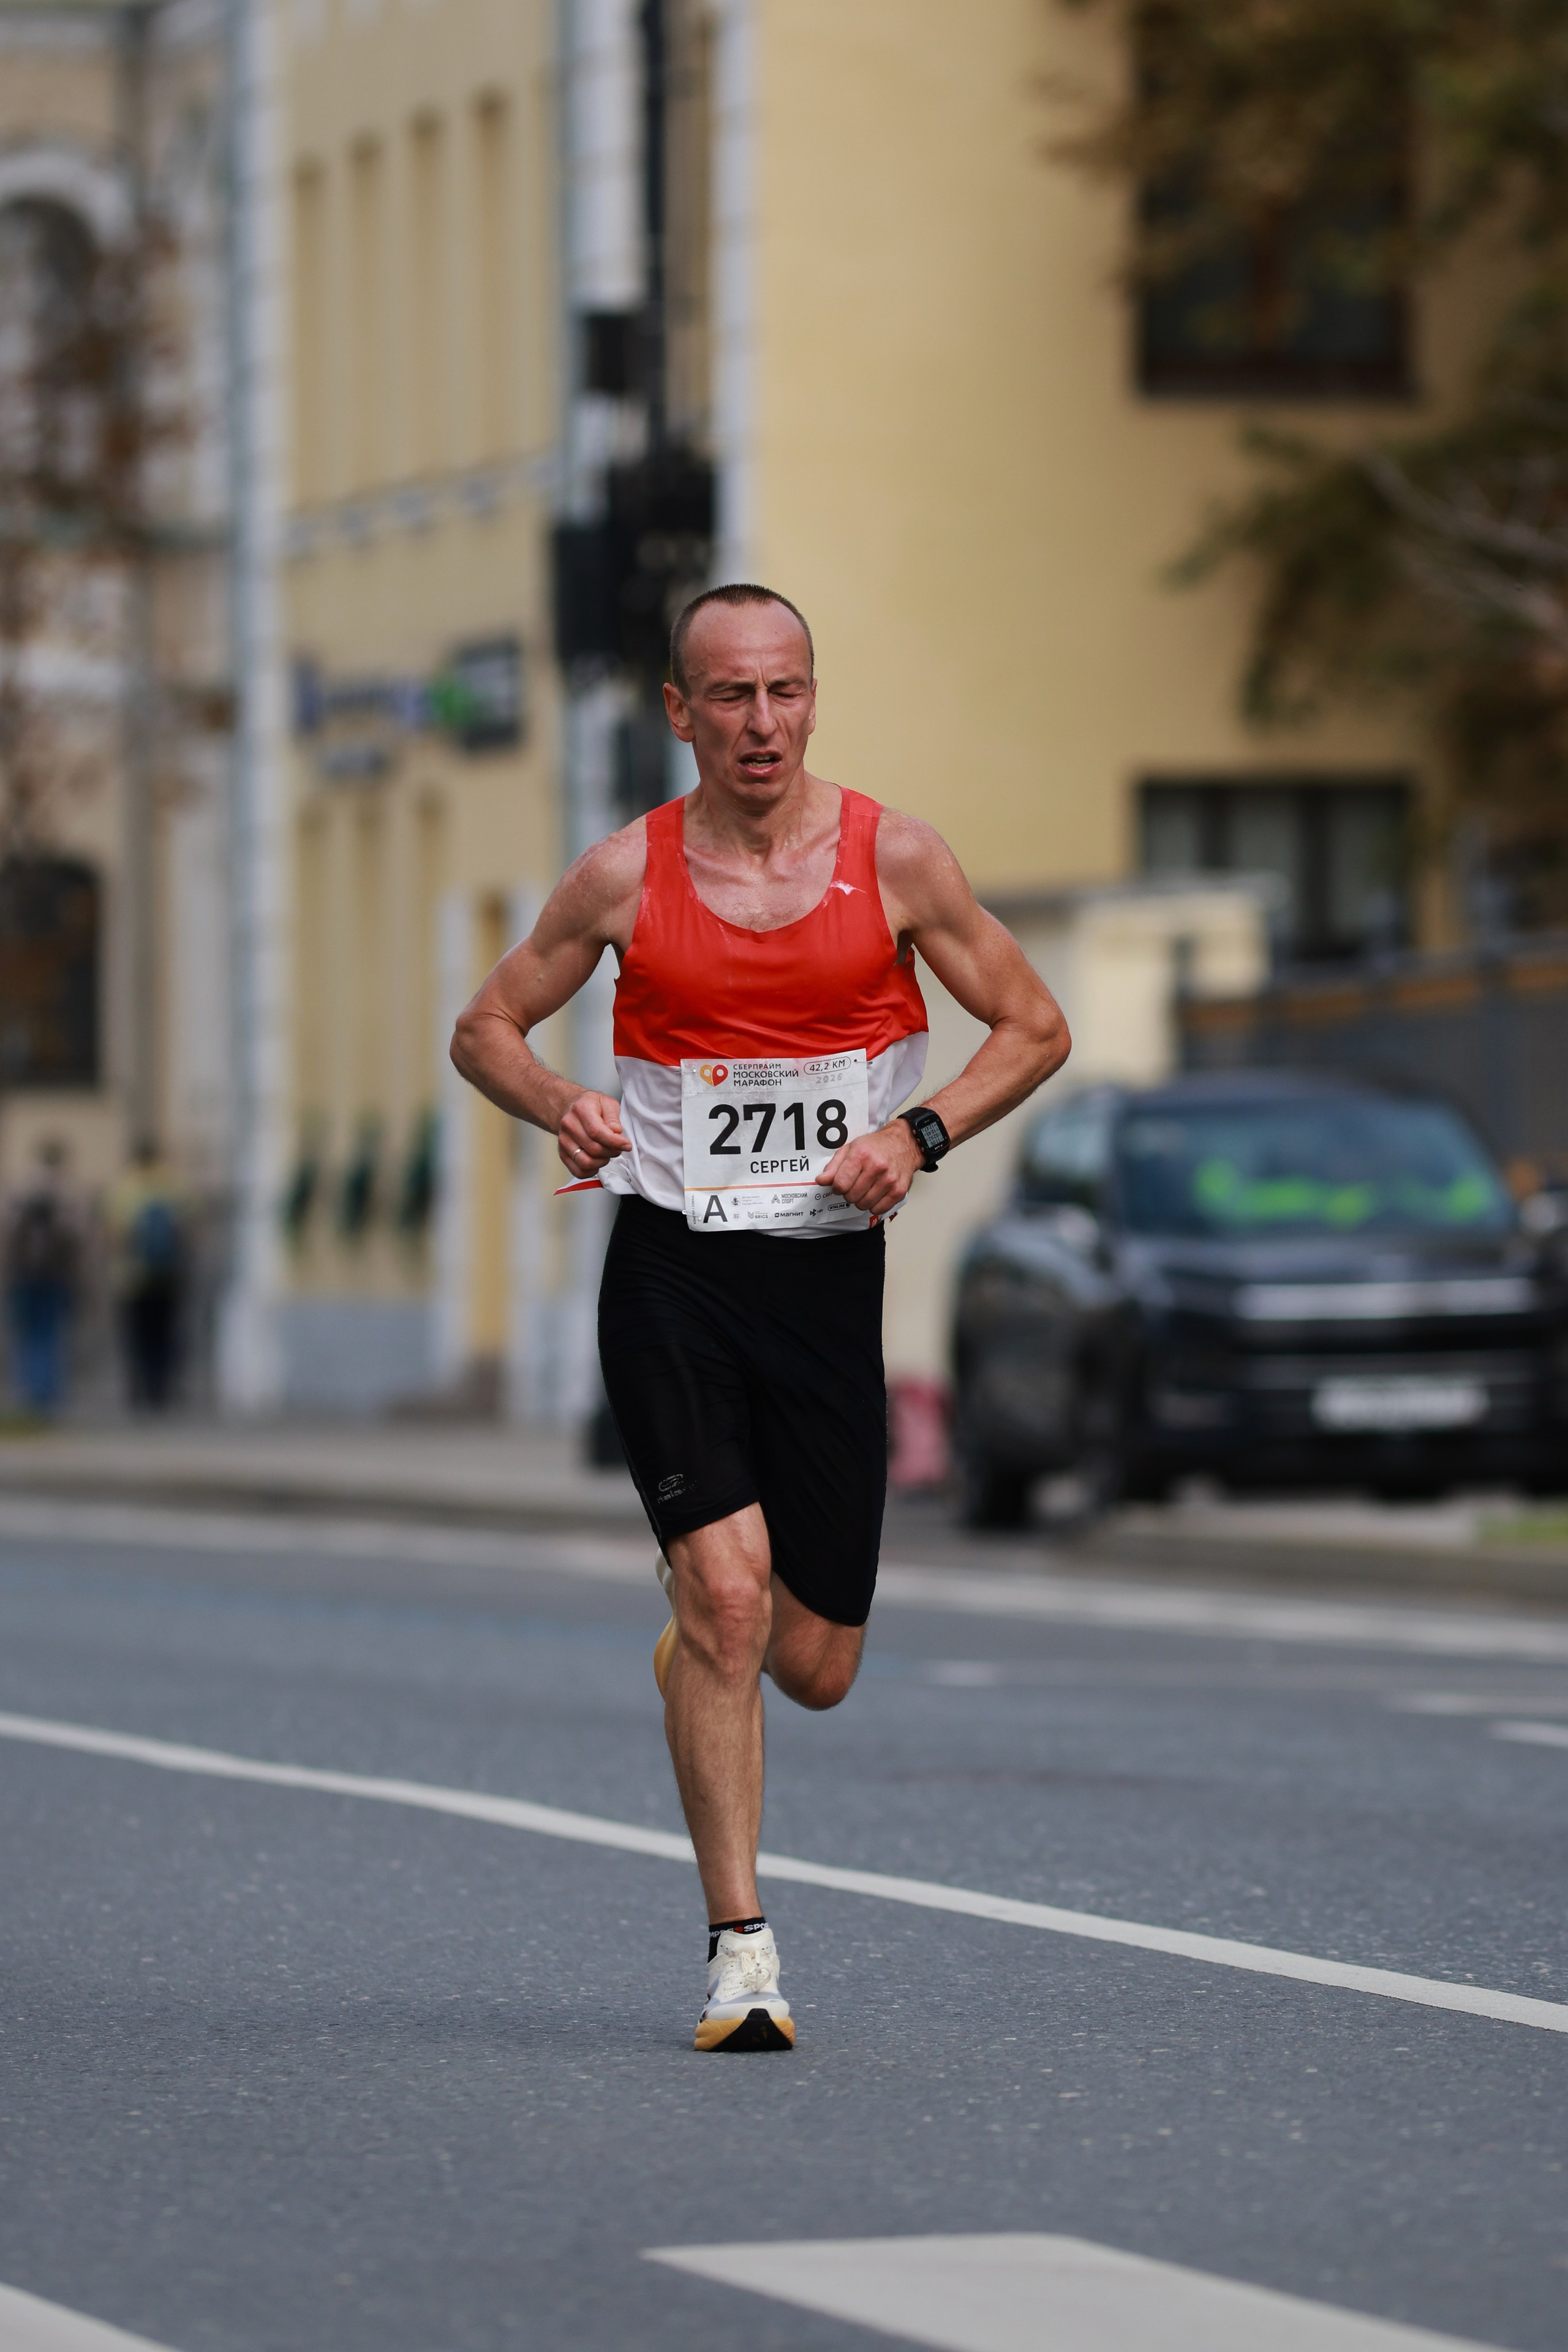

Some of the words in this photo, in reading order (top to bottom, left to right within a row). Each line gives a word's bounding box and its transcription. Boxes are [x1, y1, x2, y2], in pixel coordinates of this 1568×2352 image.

[810, 1063, 829, 1072] 42,2
[832, 1059, 845, 1068] КМ
[733, 1069, 799, 1079] МОСКОВСКИЙ
[816, 1073, 843, 1084] 2026
[709, 1099, 848, 1155] 2718
[750, 1156, 809, 1174] СЕРГЕЙ
